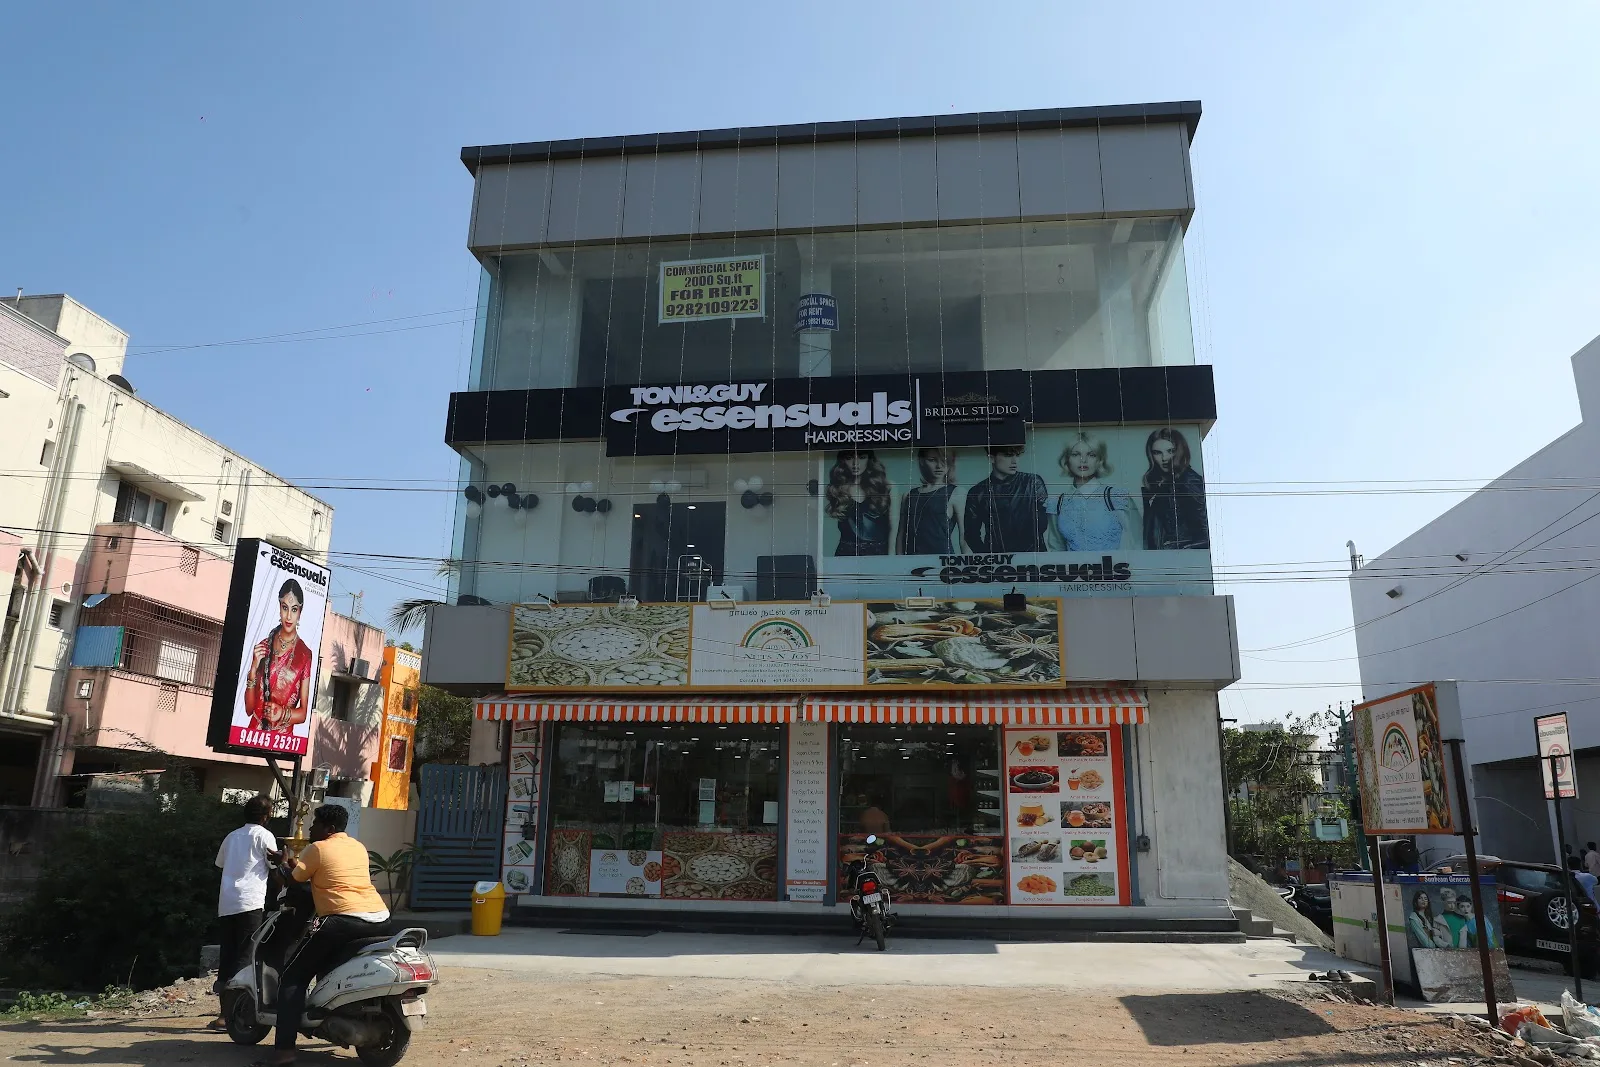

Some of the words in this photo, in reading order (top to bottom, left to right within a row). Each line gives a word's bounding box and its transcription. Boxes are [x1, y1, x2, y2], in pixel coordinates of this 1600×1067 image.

[665, 264, 727, 277] COMMERCIAL
[729, 261, 759, 273] SPACE
[684, 274, 714, 287] 2000
[716, 273, 743, 286] Sq.ft
[670, 288, 704, 301] FOR
[708, 285, 753, 298] RENT
[666, 298, 759, 316] 9282109223
[819, 297, 835, 308] SPACE
[808, 307, 823, 316] RENT
[630, 383, 768, 406] TONI&GUY
[650, 392, 912, 433] essensuals
[924, 407, 968, 417] BRIDAL
[971, 405, 1019, 415] STUDIO
[804, 428, 912, 444] HAIRDRESSING
[939, 553, 1016, 567] TONI&GUY
[270, 554, 327, 587] essensuals
[939, 556, 1132, 584] essensuals
[1059, 583, 1132, 592] HAIRDRESSING
[239, 728, 271, 748] 94445
[272, 734, 301, 751] 25217
